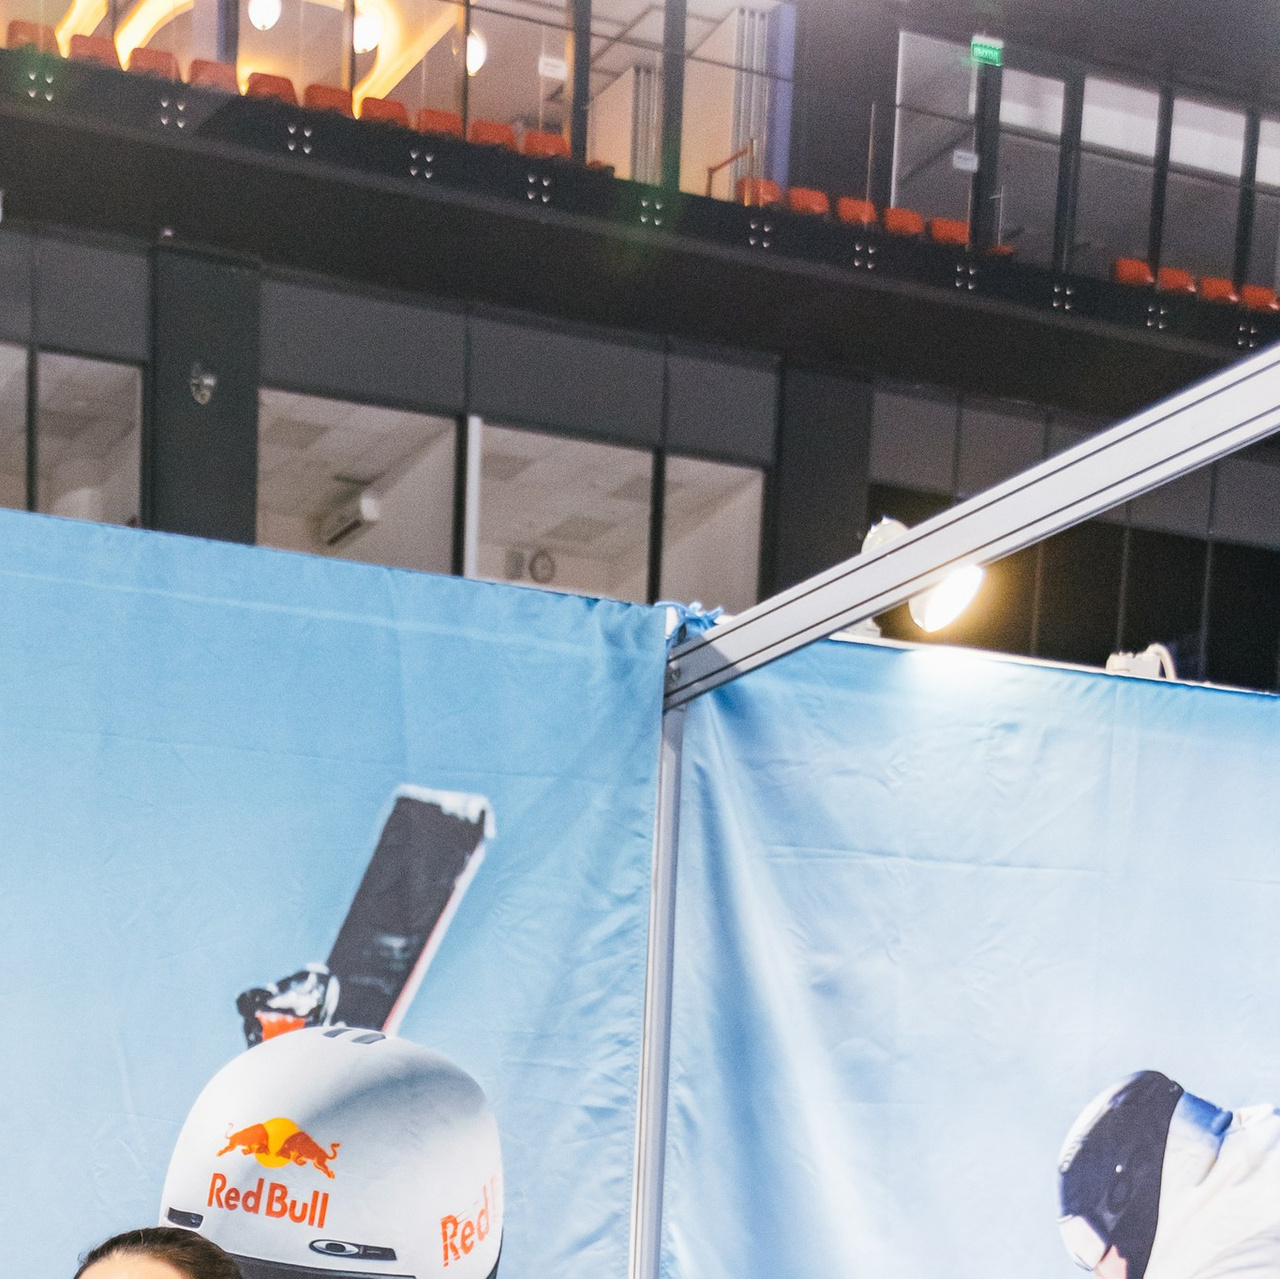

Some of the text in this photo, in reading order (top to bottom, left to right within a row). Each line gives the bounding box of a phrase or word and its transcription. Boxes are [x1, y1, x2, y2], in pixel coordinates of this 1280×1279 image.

[207, 1173, 330, 1229] Red Bull
[440, 1182, 490, 1268] Red
